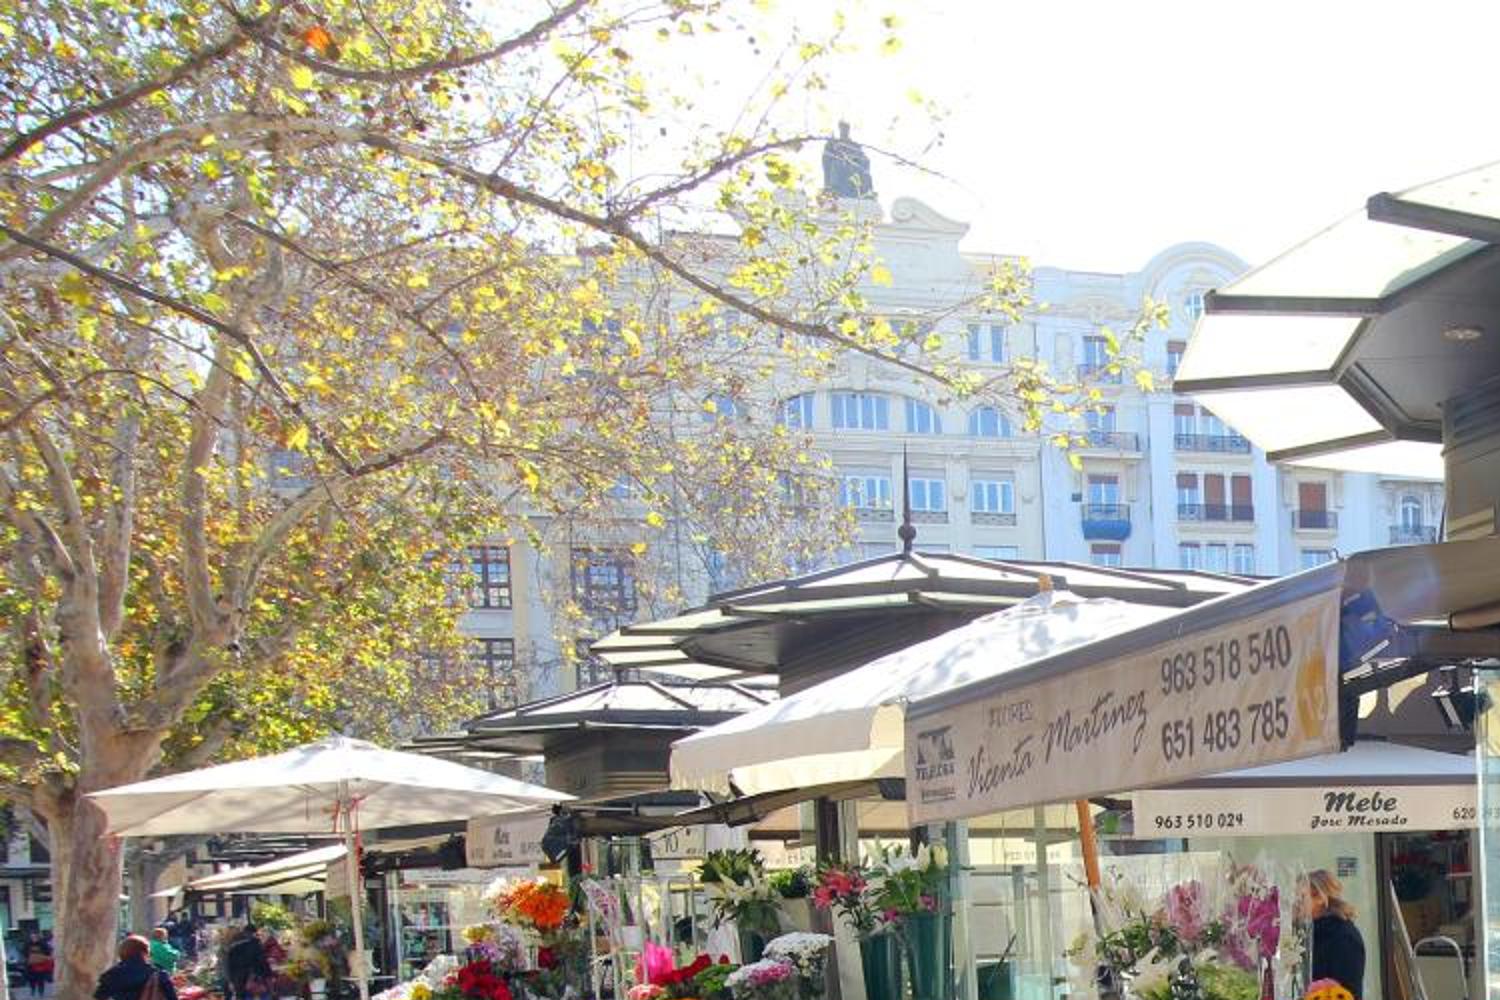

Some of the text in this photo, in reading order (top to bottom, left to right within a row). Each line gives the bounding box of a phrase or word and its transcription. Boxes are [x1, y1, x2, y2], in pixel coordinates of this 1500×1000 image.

[1161, 624, 1291, 696] 963 518 540
[1162, 696, 1289, 762] 651 483 785
[967, 735, 1034, 798] Vicenta
[1155, 813, 1244, 829] 963 510 024
[1324, 791, 1399, 813] Mebe
[1453, 807, 1476, 820] 620
